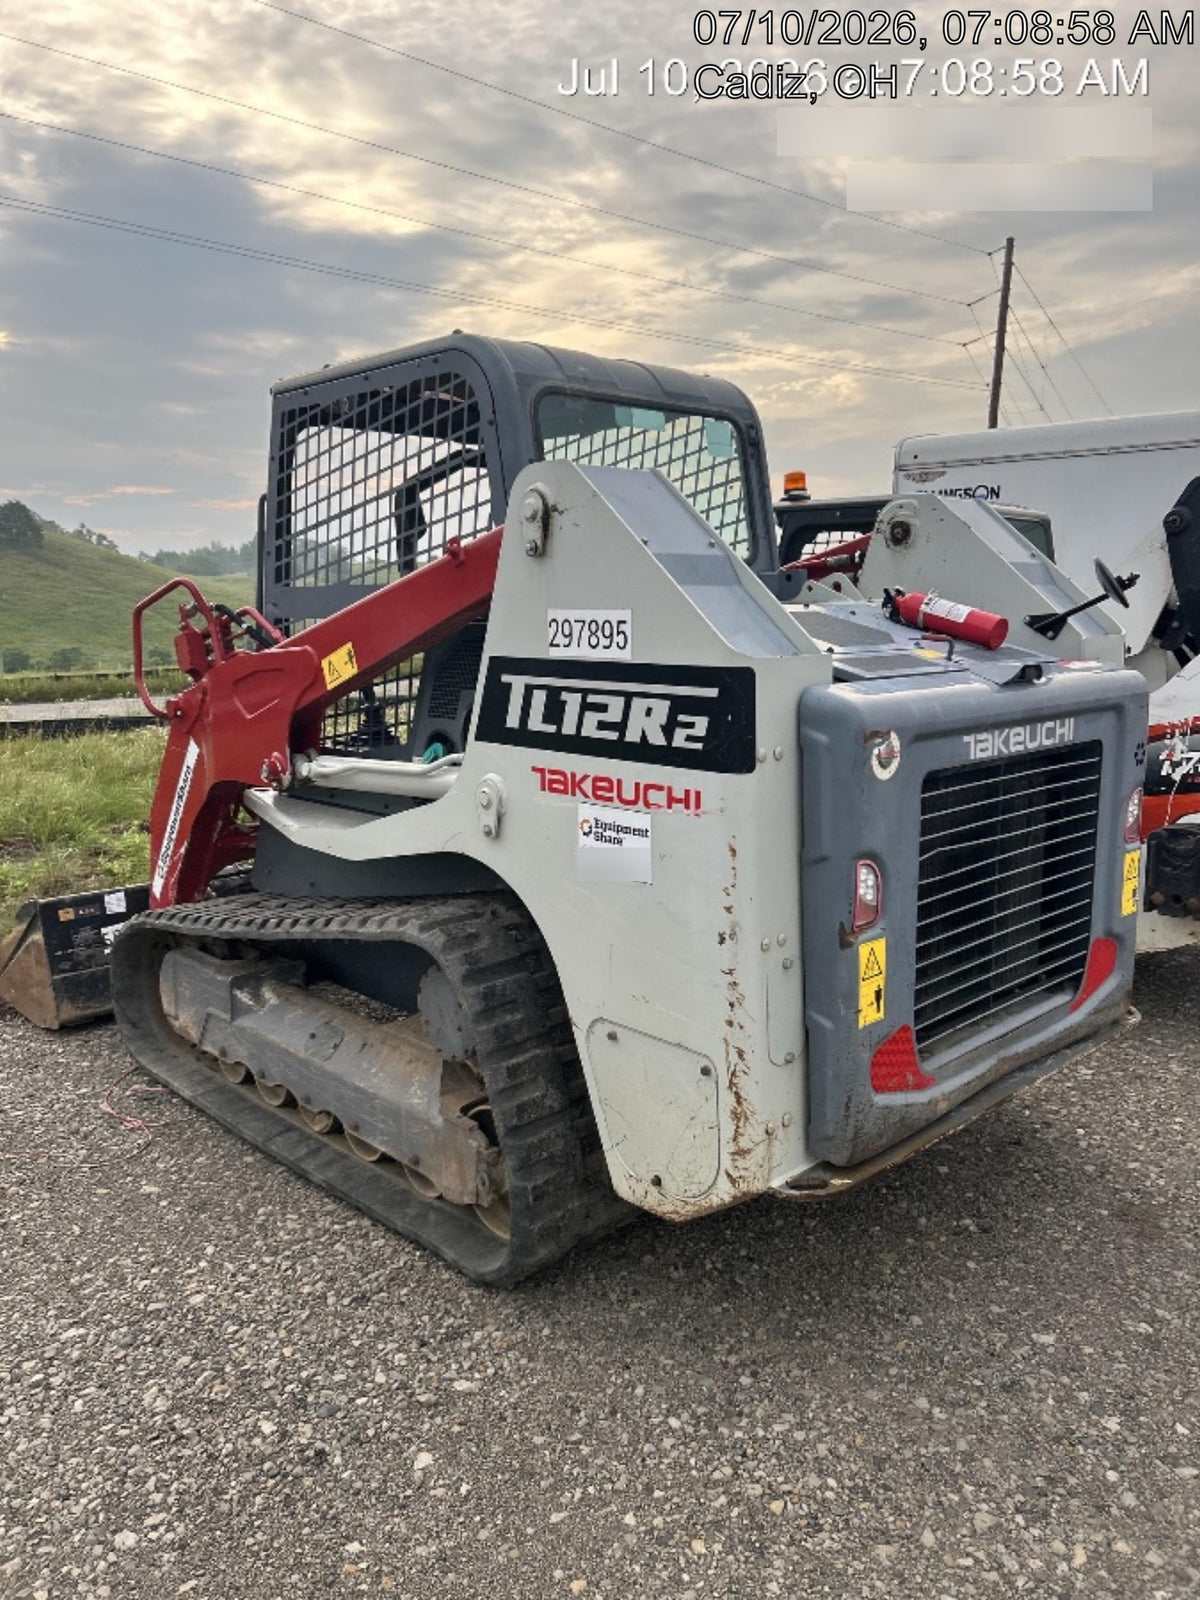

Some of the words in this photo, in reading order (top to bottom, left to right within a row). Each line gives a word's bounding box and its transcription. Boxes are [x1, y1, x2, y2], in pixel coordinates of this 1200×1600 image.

[548, 618, 628, 650] 297895
[501, 674, 719, 750] TL12R2
[593, 817, 650, 839] Equipment
[593, 831, 624, 846] Share
